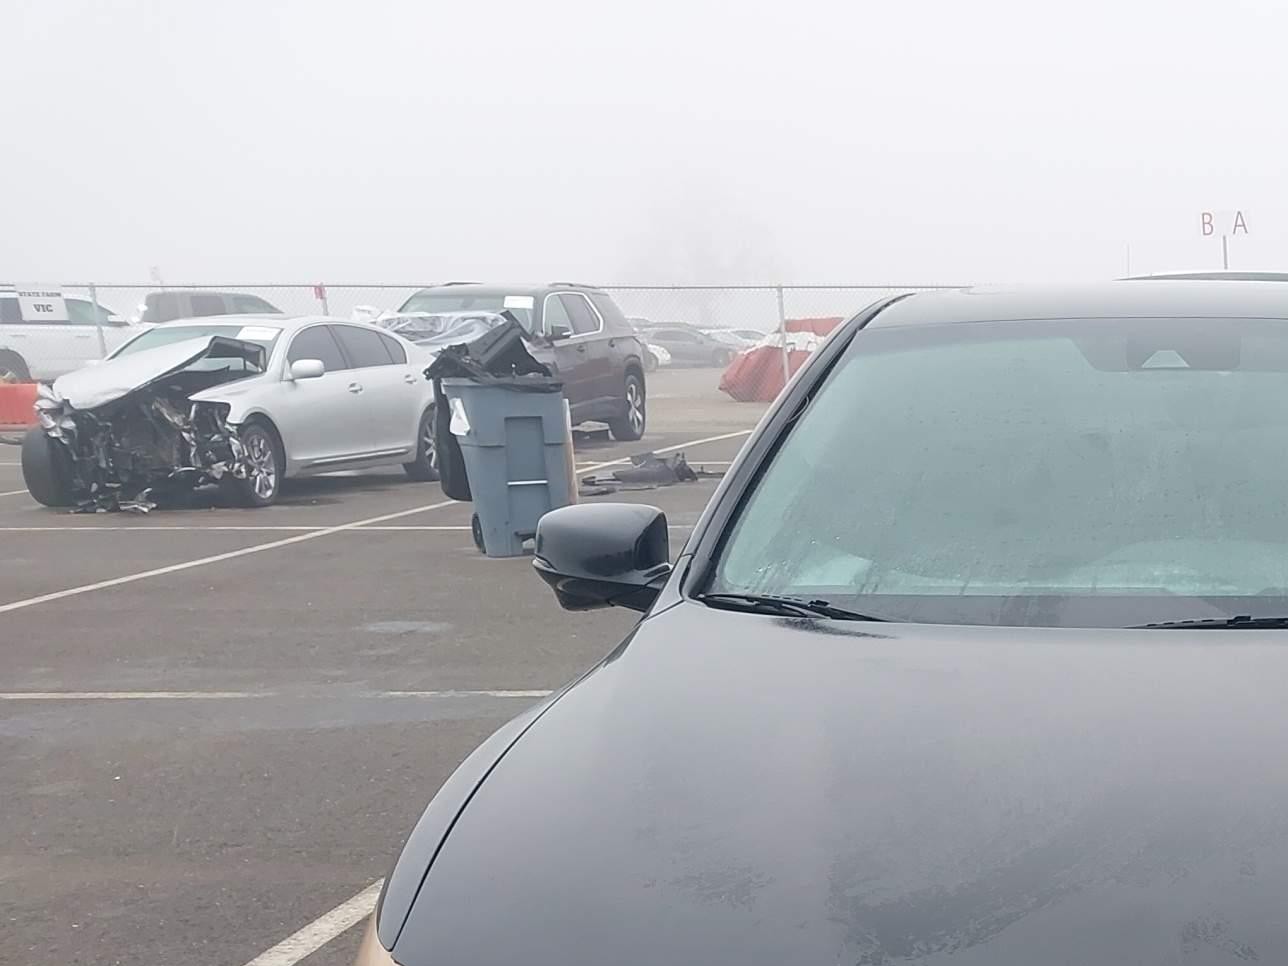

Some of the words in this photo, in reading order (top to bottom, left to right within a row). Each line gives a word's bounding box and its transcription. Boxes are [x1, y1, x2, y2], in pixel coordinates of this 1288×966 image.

[1201, 211, 1214, 236] B
[1232, 210, 1249, 235] A
[33, 303, 54, 313] VIC
